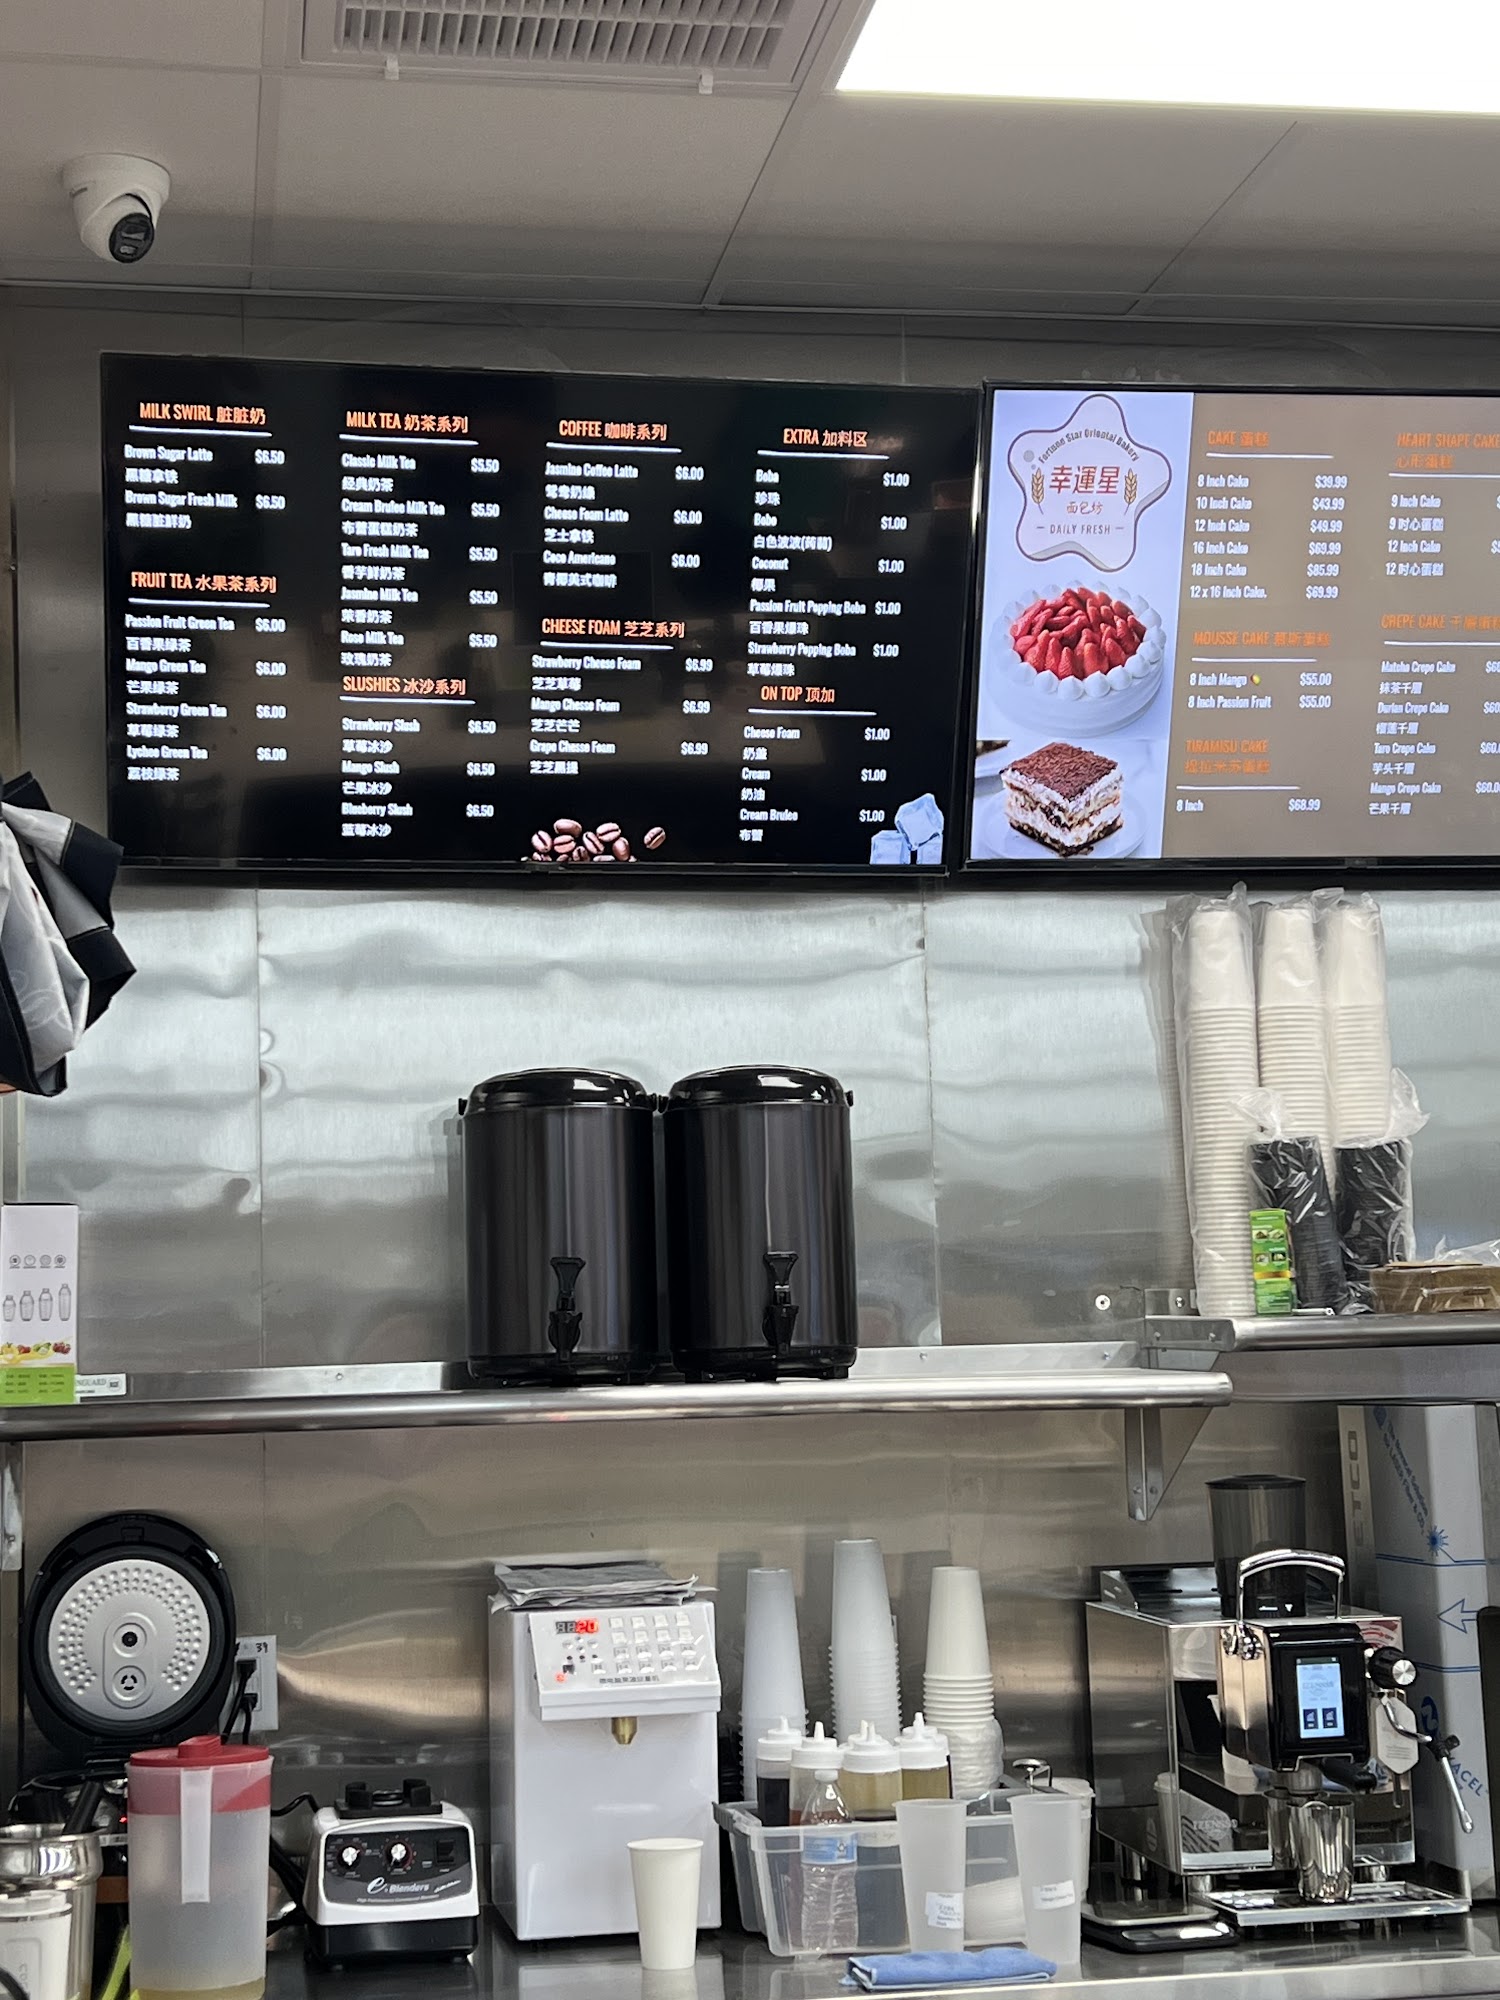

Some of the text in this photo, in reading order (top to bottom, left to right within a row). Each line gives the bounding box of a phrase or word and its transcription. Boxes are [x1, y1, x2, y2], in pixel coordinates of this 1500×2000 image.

[140, 402, 170, 419] MILK
[173, 404, 213, 421] SWIRL
[347, 411, 468, 433] MILK TEA 奶茶系列
[559, 420, 667, 440] COFFEE 咖啡系列
[784, 428, 867, 447] EXTRA 加料区
[1038, 428, 1139, 464] Fortune Star Oriental Bakery
[125, 444, 284, 464] Brown Sugar Latte $6.50
[342, 454, 499, 472] Classic Milk Tea $5.50
[545, 462, 704, 480] Jasmine Coffee Latte $6.00
[756, 469, 909, 486] Boba $1.00
[1049, 465, 1120, 494] 幸運星
[1198, 475, 1347, 489] 8 Inch Cake $39.99
[125, 490, 285, 509] Brown Sugar Fresh Milk $6.50
[1196, 497, 1207, 509] 10
[1210, 497, 1228, 509] Inch
[1230, 497, 1252, 510] Cake
[1392, 494, 1441, 508] 9 Inch Cake
[544, 506, 702, 524] Cheese Foam Latte $6.00
[1050, 524, 1111, 534] DAILY FRESH
[1195, 519, 1343, 533] 12 Inch Cake $49.99
[342, 543, 498, 561] Taro Fresh Milk Tea $5.50
[1193, 542, 1341, 555] 16 Inch Cake $69.99
[1388, 540, 1441, 553] 12 Inch Cake
[752, 556, 904, 573] Coconut $1.00
[1192, 563, 1339, 577] 18 Inch Cake $85.99
[132, 572, 276, 593] FRUIT TEA 水果茶系列
[341, 587, 498, 604] Jasmine Milk Tea $5.50
[750, 599, 901, 615] Passion Fruit Popping Boba $1.00
[126, 614, 286, 632] Passion Fruit Green Tea $6.00
[542, 618, 685, 638] CHEESE FOAM 芝芝系列
[1381, 615, 1415, 629] CREPE
[1419, 615, 1445, 629] CAKE
[341, 630, 497, 648] Rose Milk Tea $5.50
[748, 642, 898, 657] Strawberry Popping Boba $1.00
[126, 659, 286, 676] Mango Green Tea $6.00
[343, 676, 466, 695] SLUSHIES 冰沙系列
[1190, 673, 1332, 687] 8 Inch Mango $55.00
[761, 686, 834, 703] ON TOP 顶加
[1188, 695, 1331, 708] 8 Inch Passion Fruit $55.00
[127, 702, 286, 719] Strawberry Green Tea $6.00
[342, 718, 496, 733] Strawberry Slush $6.50
[744, 726, 890, 740] Cheese Foam $1.00
[127, 745, 287, 761] Lychee Green Tea $6.00
[1186, 740, 1268, 753] TIRAMISU CAKE
[342, 761, 495, 776] Mango Slush $6.50
[742, 767, 886, 781] Cream $1.00
[740, 809, 768, 820] Cream
[860, 810, 884, 822] $1.00
